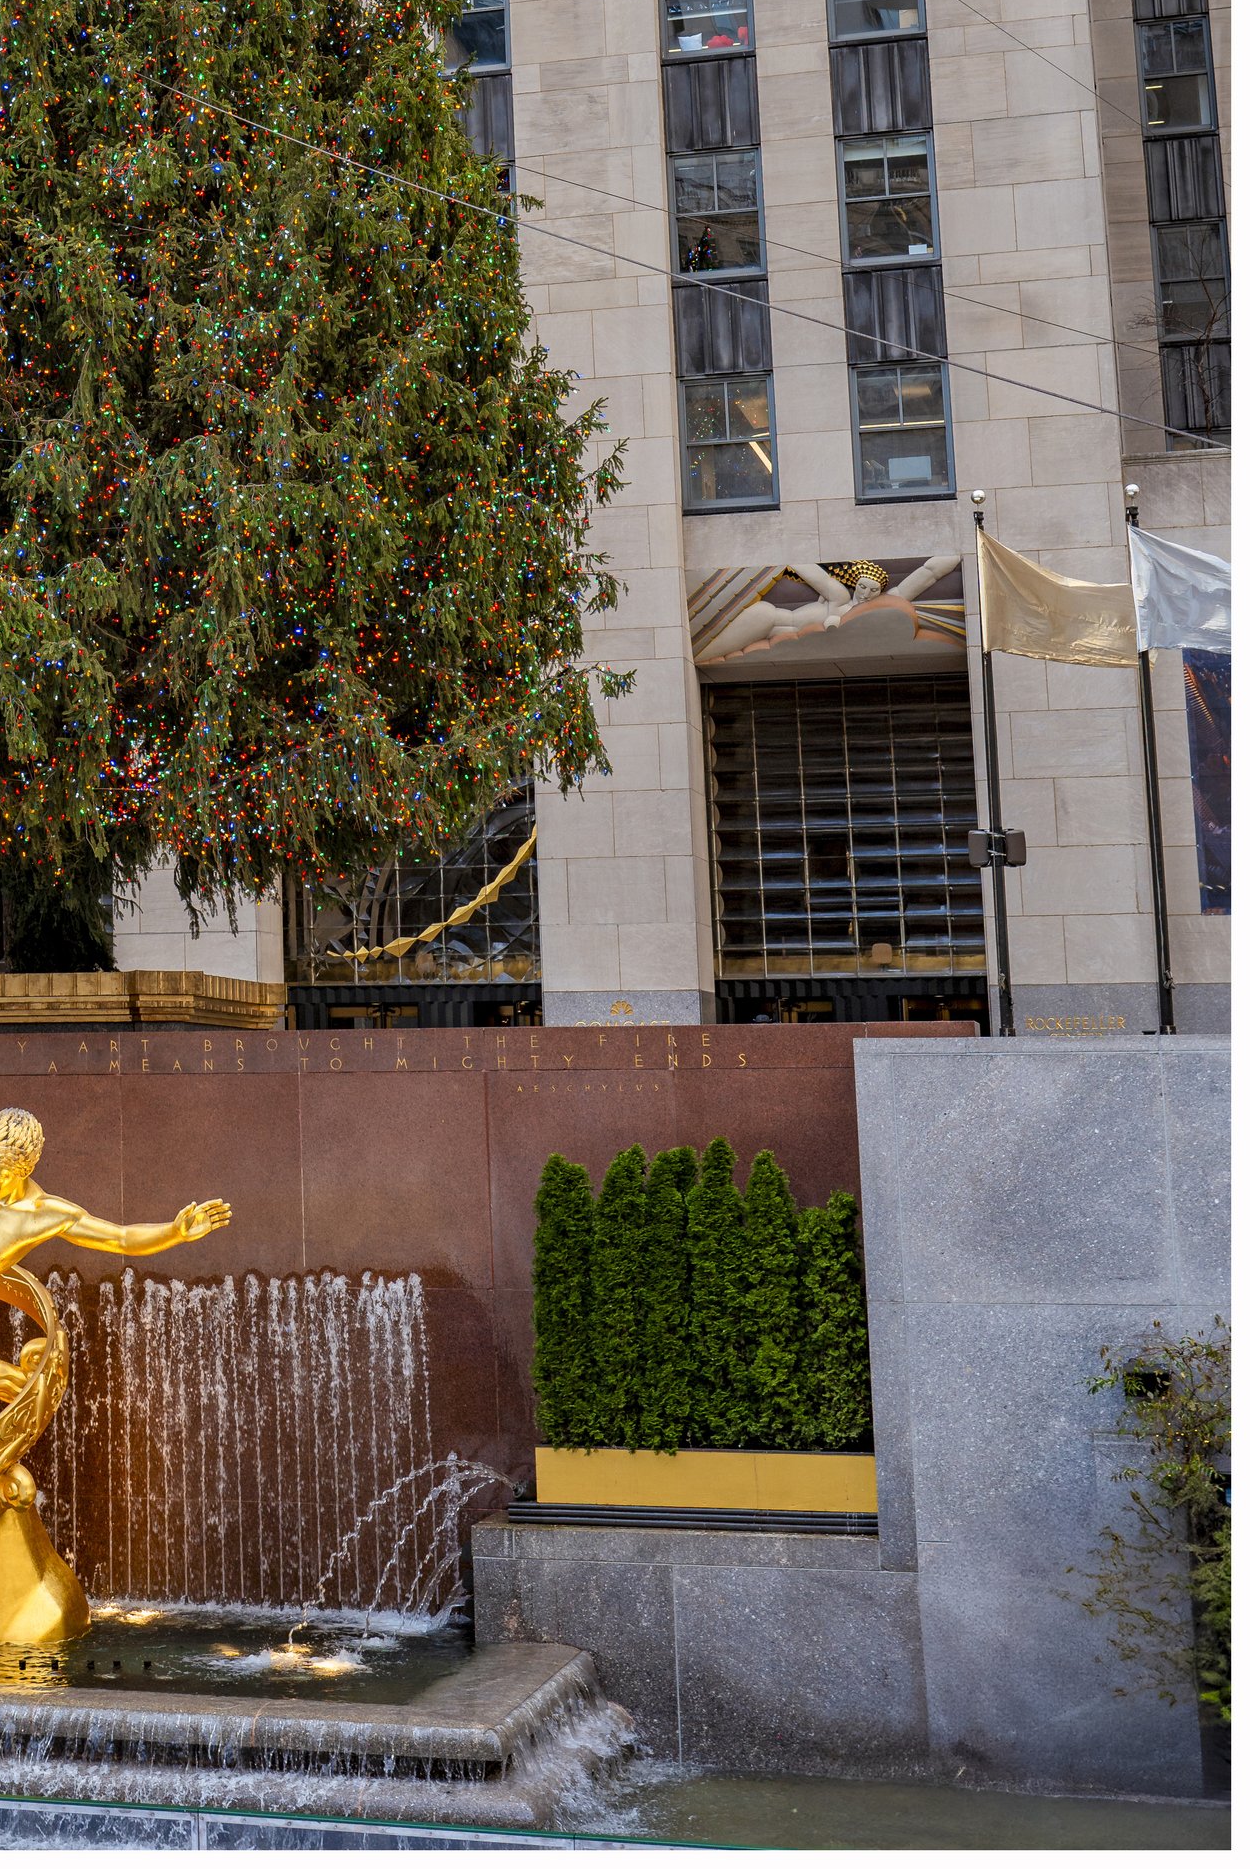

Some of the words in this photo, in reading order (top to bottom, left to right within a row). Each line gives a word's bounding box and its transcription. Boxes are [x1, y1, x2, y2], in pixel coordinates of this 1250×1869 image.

[1025, 1016, 1126, 1030] ROCKEFELLER
[78, 1039, 149, 1053] ART
[204, 1037, 406, 1052] BROUGHT
[463, 1035, 540, 1049] THE
[599, 1033, 711, 1048] FIRE
[48, 1060, 58, 1073] A
[109, 1058, 244, 1073] MEANS
[300, 1058, 342, 1071] TO
[395, 1055, 574, 1069] MIGHTY
[635, 1053, 747, 1068] ENDS
[517, 1084, 659, 1093] AESCHYLUS
